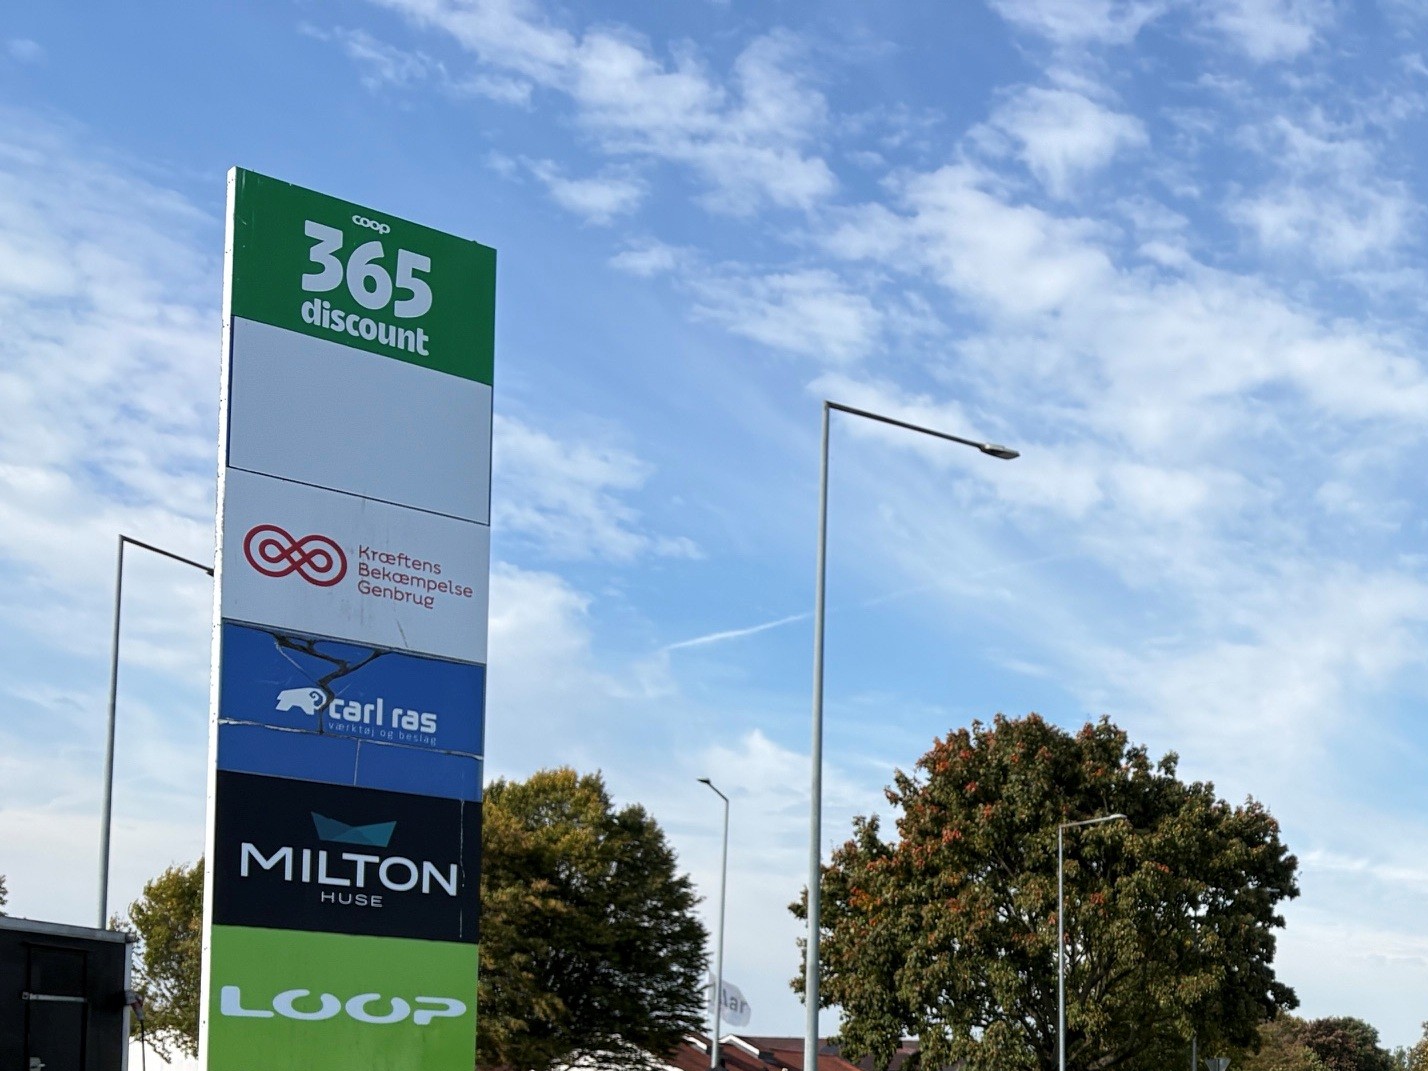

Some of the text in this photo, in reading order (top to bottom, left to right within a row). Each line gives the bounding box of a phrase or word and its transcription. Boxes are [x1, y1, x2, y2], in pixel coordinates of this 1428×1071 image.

[352, 214, 391, 235] coop
[301, 219, 433, 319] 365
[301, 298, 430, 357] discount
[359, 545, 442, 575] Kræftens
[357, 580, 435, 610] Genbrug
[359, 562, 474, 598] Bekæmpelse
[328, 697, 437, 734] carl ras
[328, 721, 437, 747] værktøj og beslag
[240, 842, 458, 897] MILTON
[320, 891, 384, 908] HUSE
[220, 985, 467, 1026] LOOP
